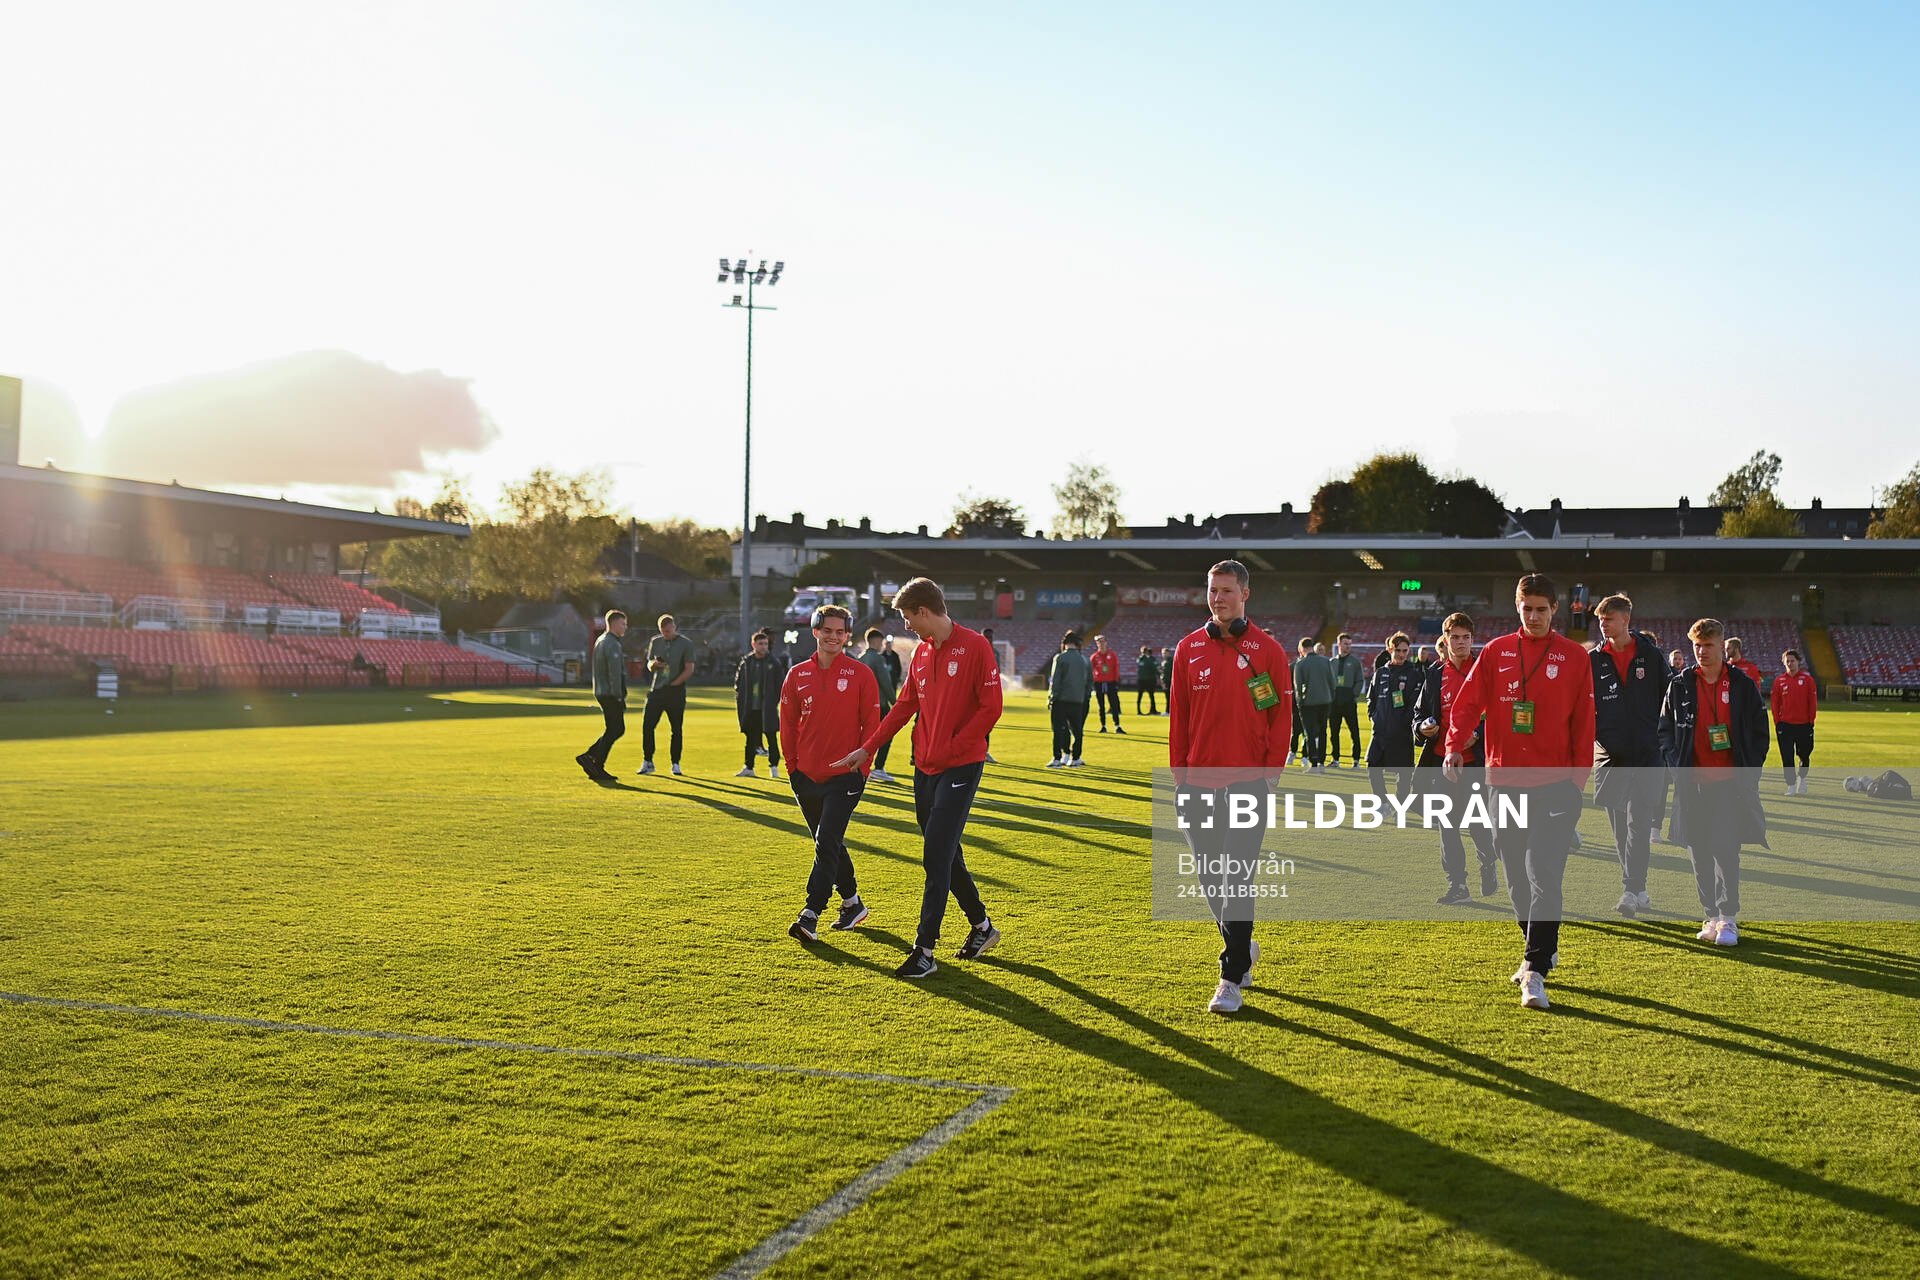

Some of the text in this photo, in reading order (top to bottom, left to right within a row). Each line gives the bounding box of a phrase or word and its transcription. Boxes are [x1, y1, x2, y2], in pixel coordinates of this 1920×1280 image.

[1052, 592, 1082, 605] JAKO
[1242, 640, 1260, 650] DNB
[951, 647, 966, 656] DNB
[1548, 653, 1566, 662] DNB
[840, 667, 855, 676] DNB
